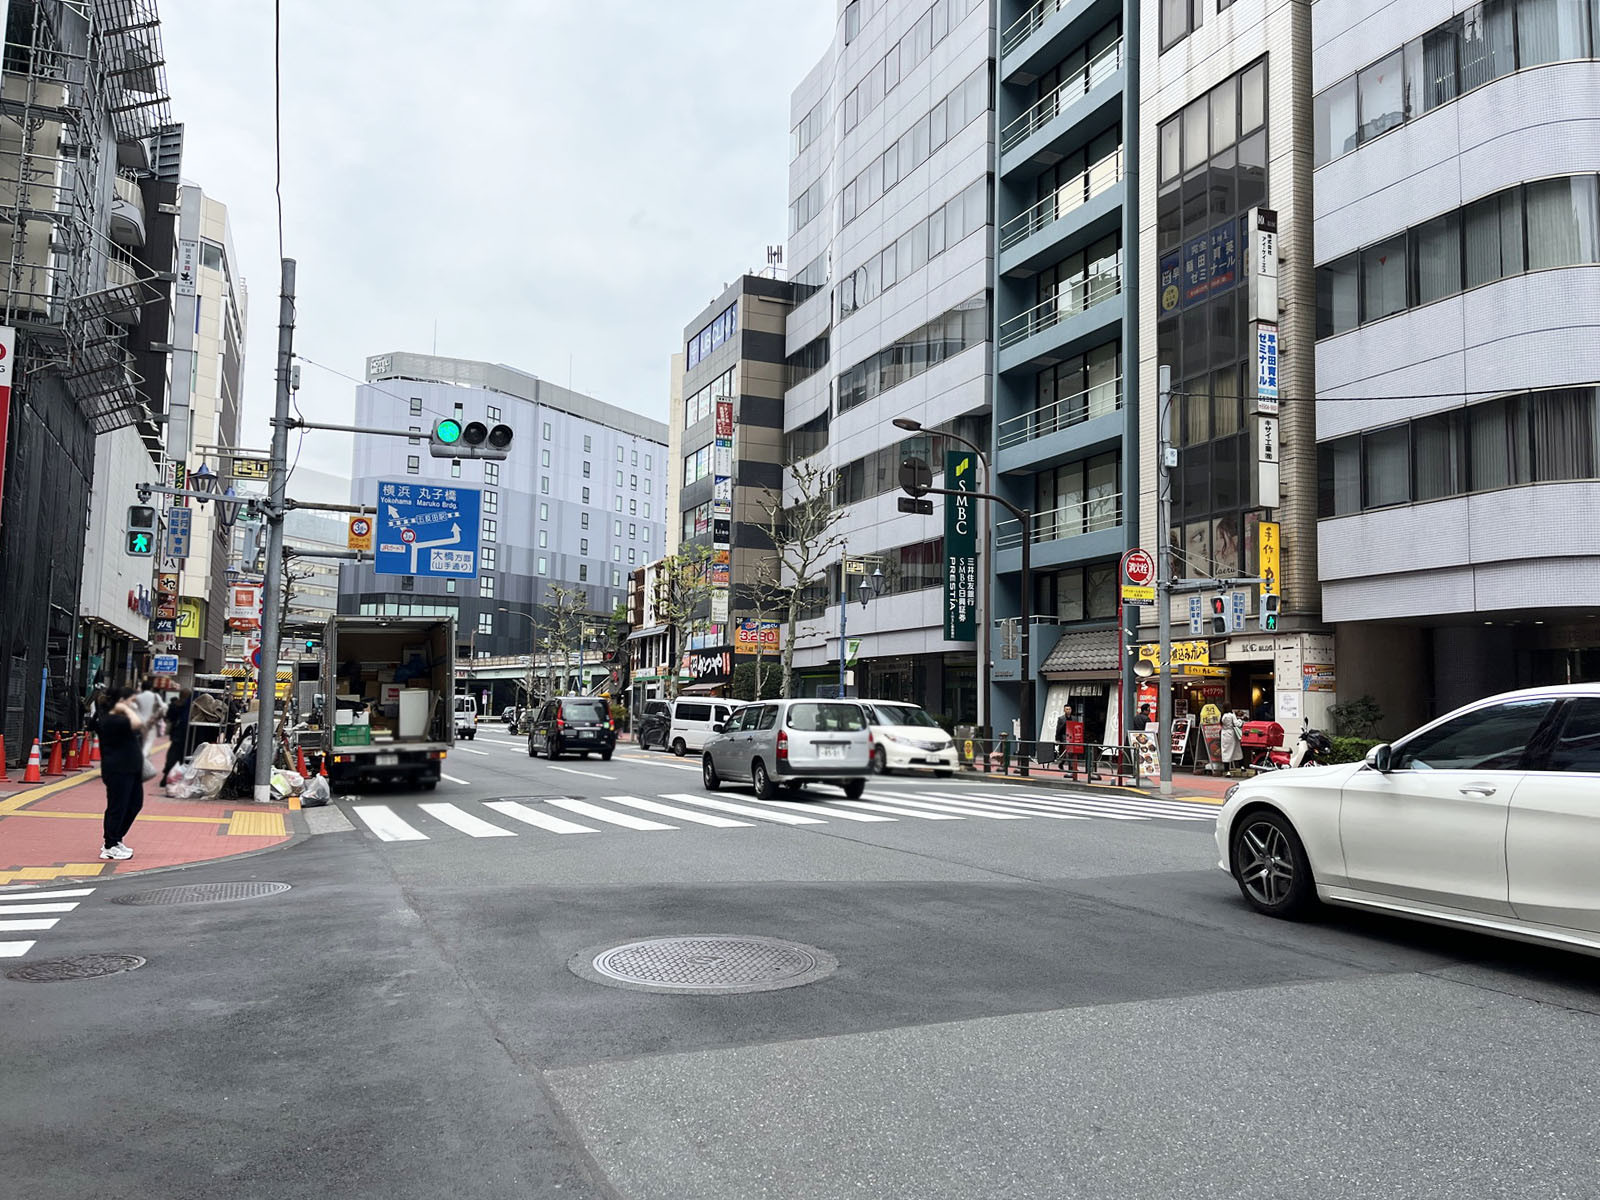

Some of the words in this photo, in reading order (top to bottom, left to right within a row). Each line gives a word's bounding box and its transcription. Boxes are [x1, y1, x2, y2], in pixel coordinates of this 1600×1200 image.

[1191, 255, 1236, 284] ゼミナール
[1259, 333, 1267, 386] ゼミナール
[1267, 333, 1277, 387] 早稲田育英
[380, 496, 412, 505] Yokohama
[416, 499, 441, 507] Maruko
[441, 501, 458, 510] Brdg.
[383, 484, 410, 498] 横浜
[418, 487, 457, 501] 丸子橋
[955, 480, 969, 535] SMBC
[431, 561, 472, 571] (山手通り)
[432, 551, 472, 562] 大橋方面
[1128, 562, 1148, 574] 消火栓
[958, 557, 966, 622] SMBC日興証券
[967, 557, 975, 606] 三井住友銀行
